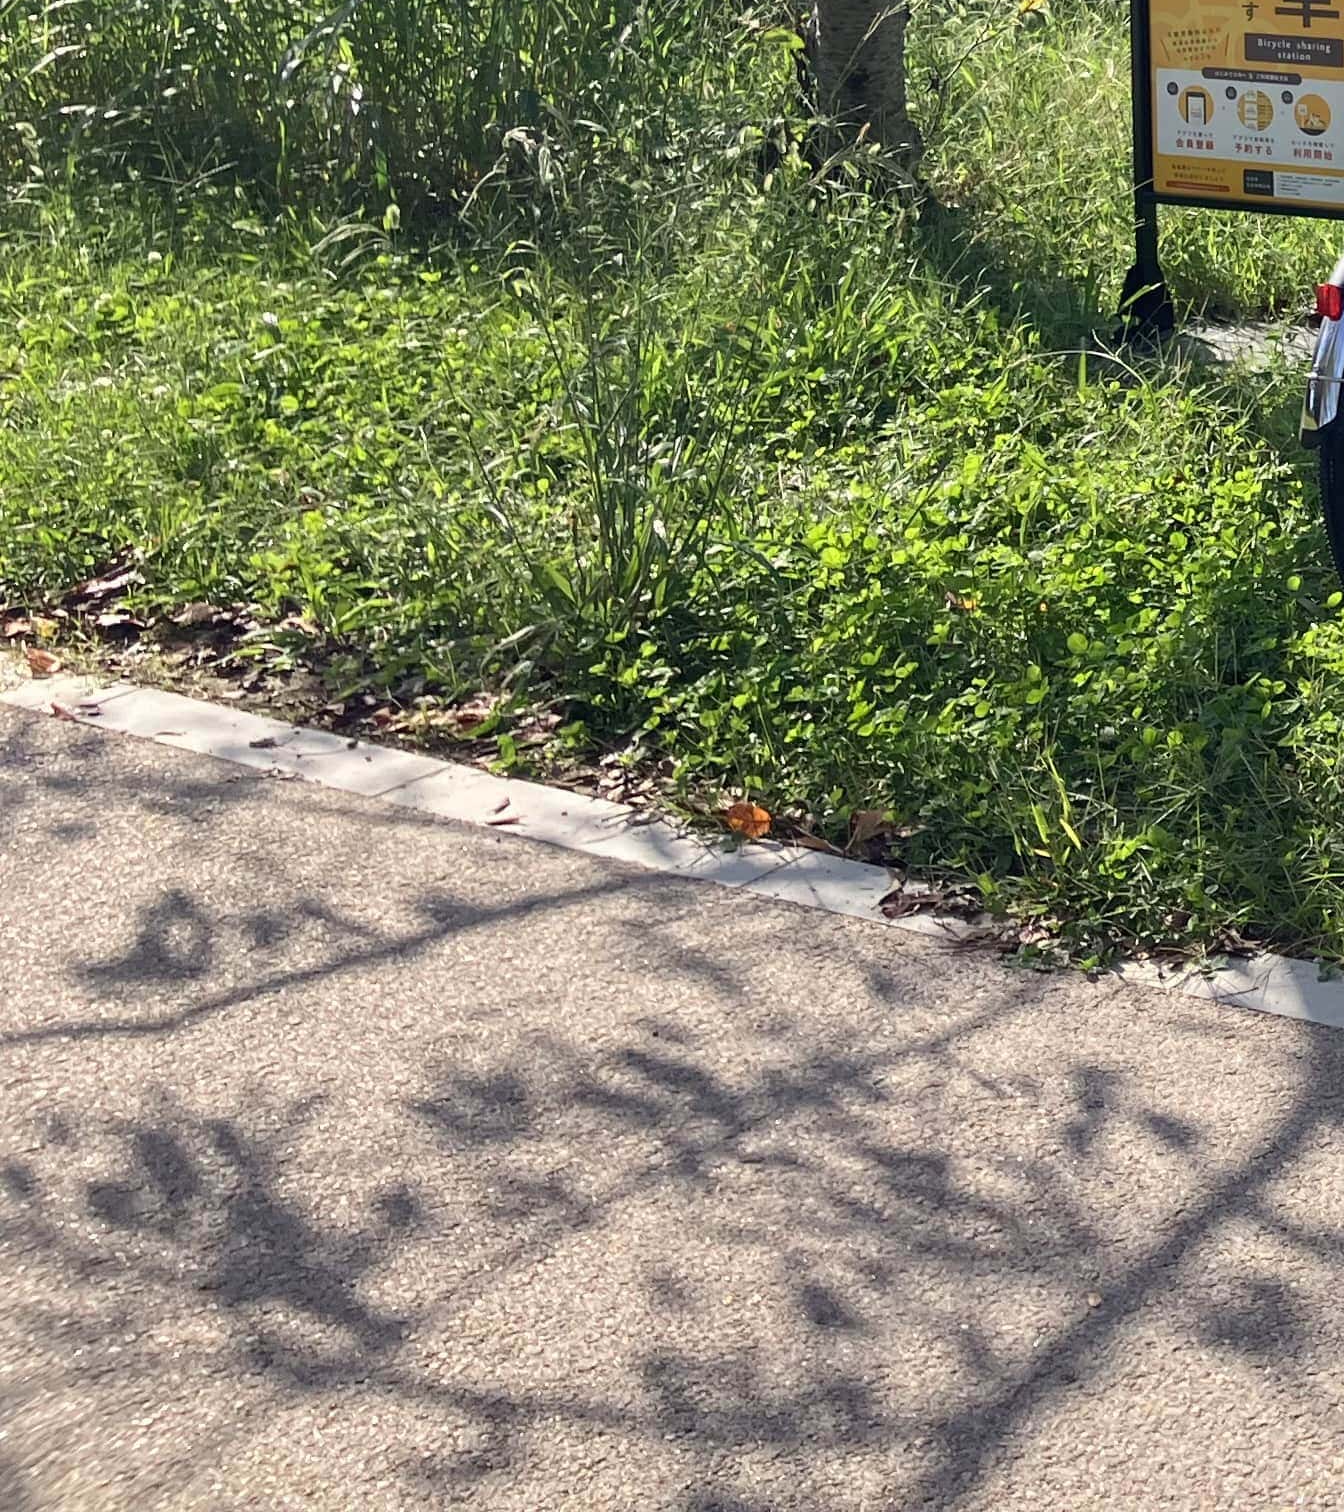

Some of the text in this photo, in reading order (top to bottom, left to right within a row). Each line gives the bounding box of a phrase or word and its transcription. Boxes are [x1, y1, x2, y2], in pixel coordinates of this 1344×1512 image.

[1257, 38, 1331, 53] Bicycle sharing
[1277, 51, 1312, 61] station
[1234, 143, 1273, 155] 予約する
